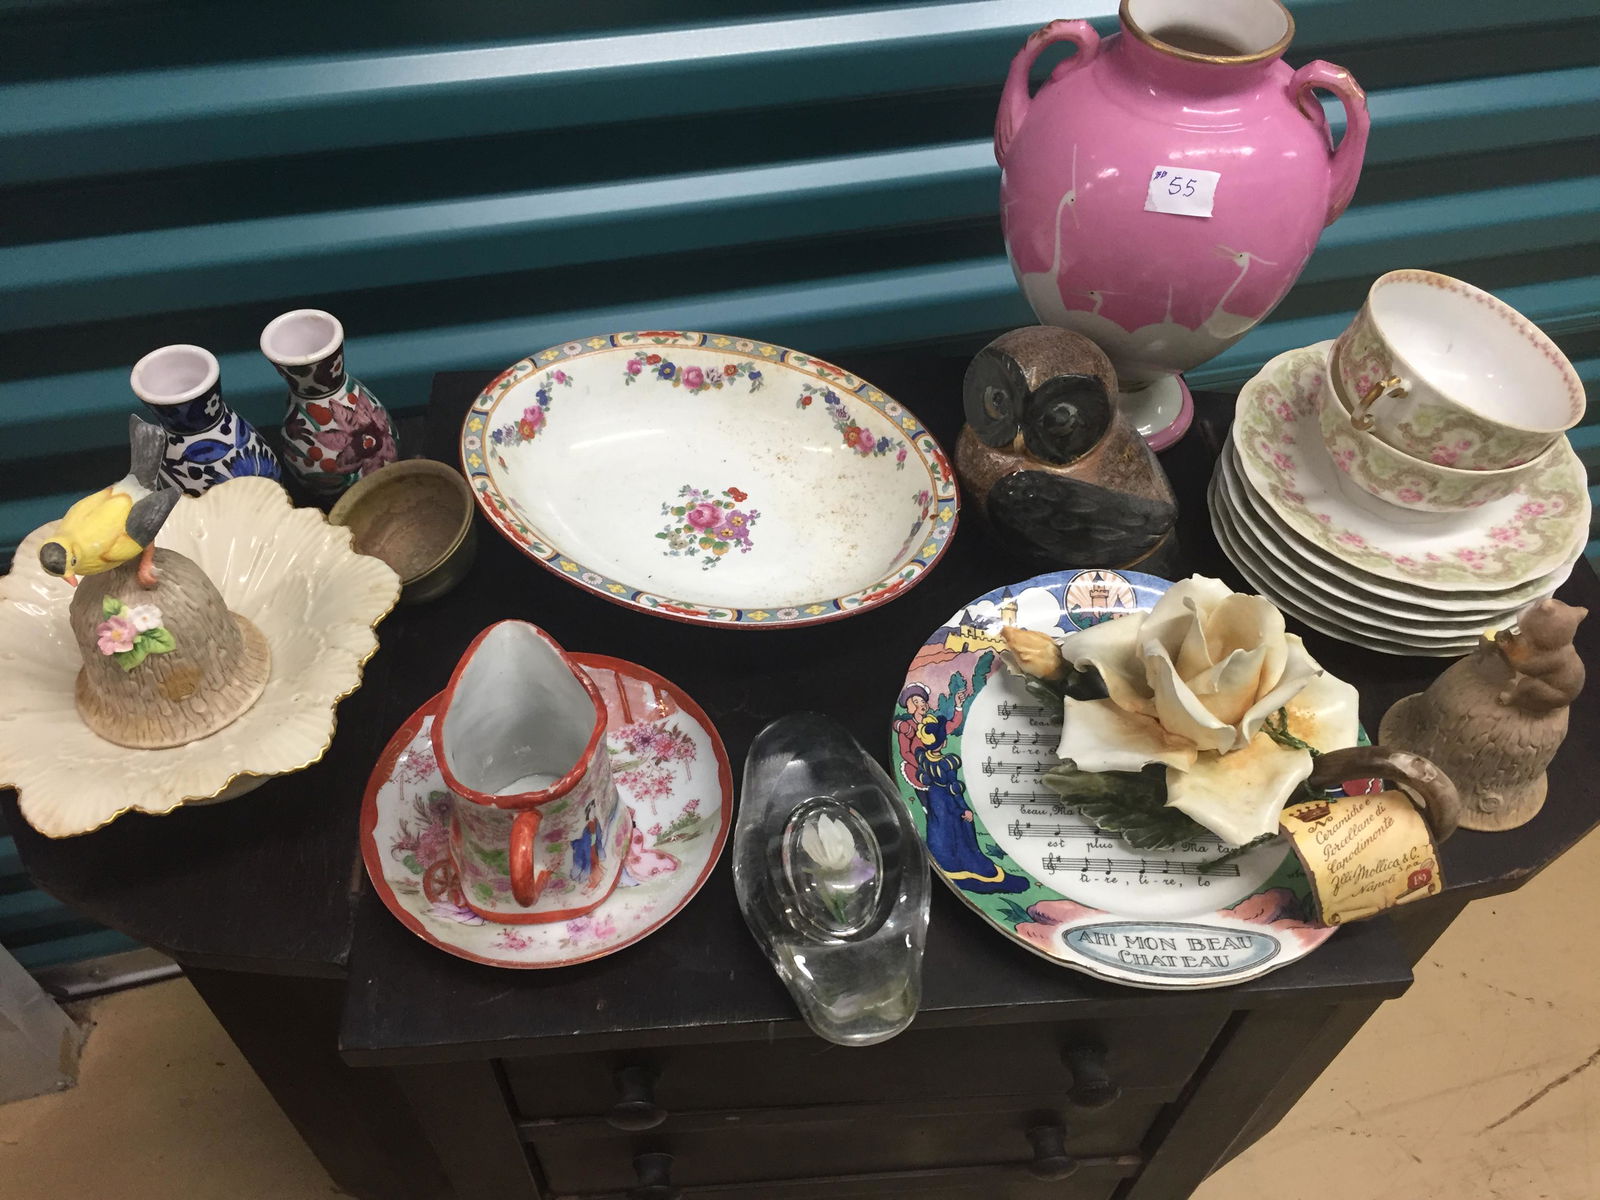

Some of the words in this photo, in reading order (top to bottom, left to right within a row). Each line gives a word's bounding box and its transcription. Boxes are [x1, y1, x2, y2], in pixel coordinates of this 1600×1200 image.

[1168, 176, 1197, 198] 55
[1316, 804, 1363, 845] Ceramiche
[1323, 814, 1374, 861] Porcellane
[1376, 802, 1386, 817] di
[1086, 837, 1113, 851] plus
[1078, 930, 1117, 947] AH!
[1124, 936, 1176, 951] MON
[1186, 935, 1254, 951] BEAU
[1118, 949, 1231, 968] CHATEAU
